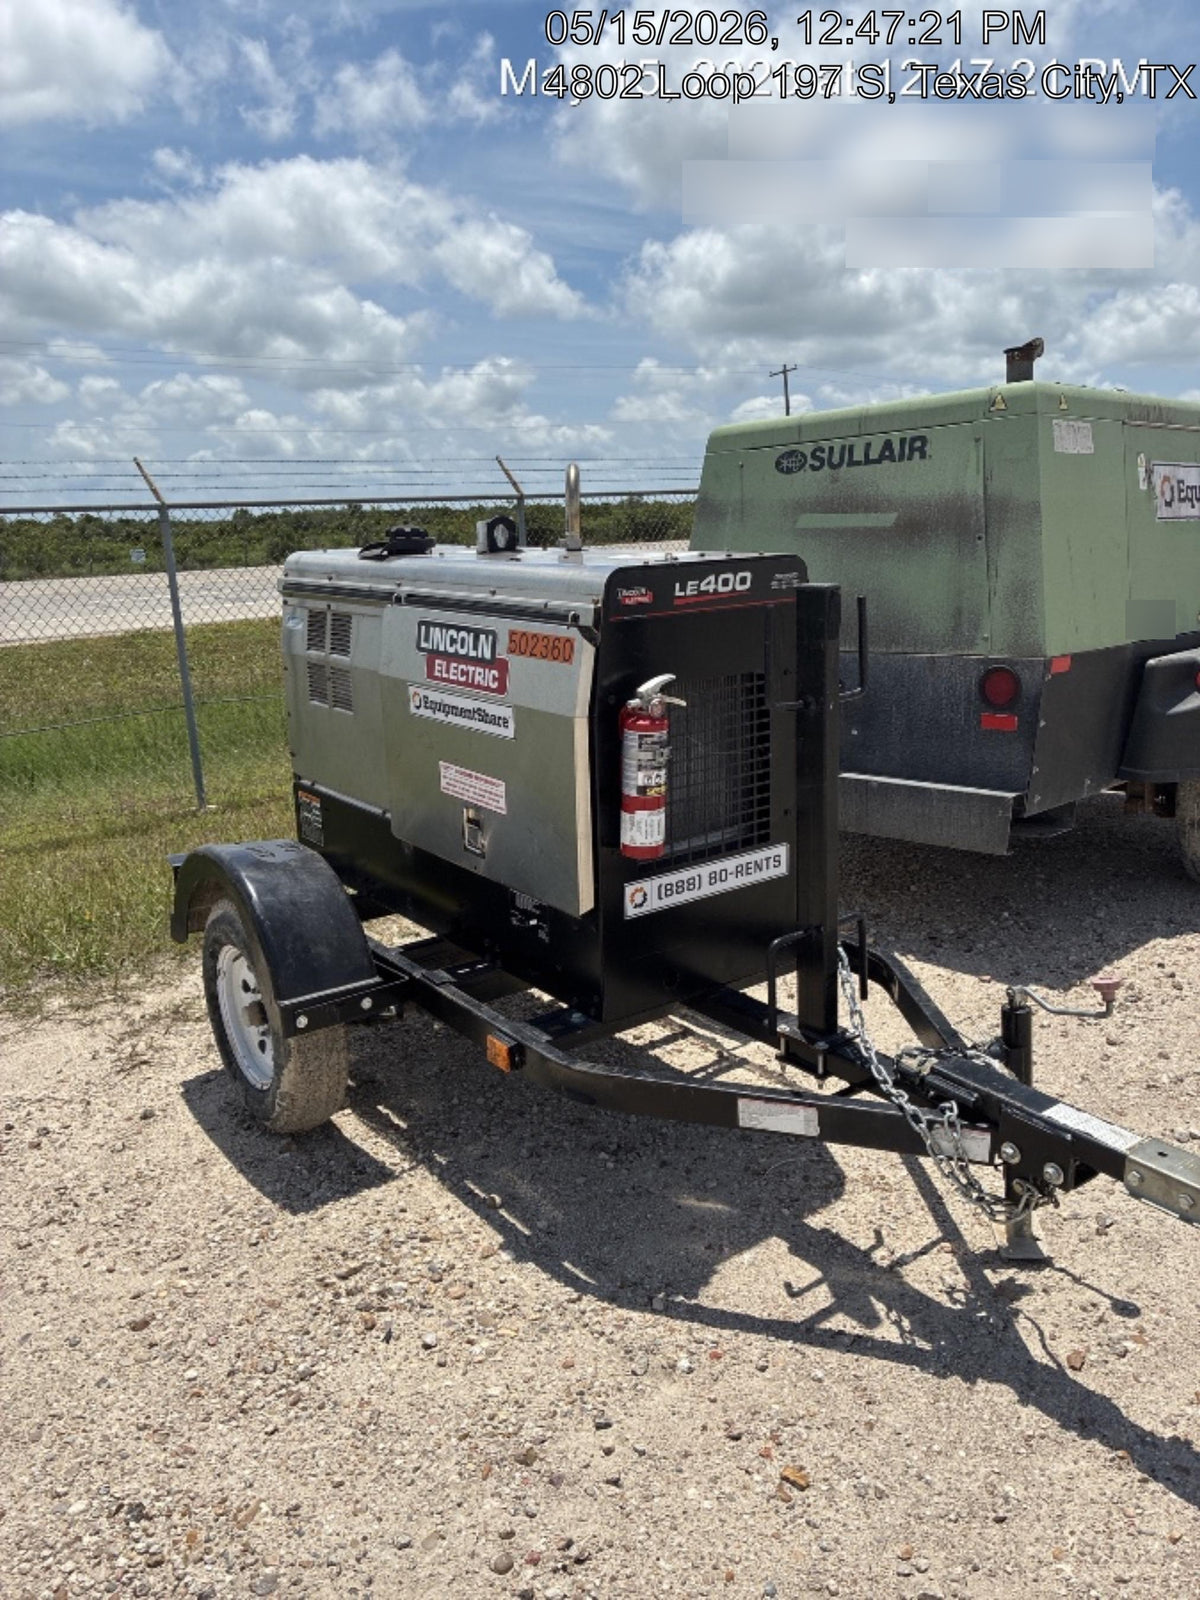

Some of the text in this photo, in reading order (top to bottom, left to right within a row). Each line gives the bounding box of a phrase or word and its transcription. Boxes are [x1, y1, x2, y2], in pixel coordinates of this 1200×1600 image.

[809, 435, 929, 472] SULLAIR
[674, 572, 752, 597] LE400
[420, 625, 493, 660] LINCOLN
[508, 631, 574, 663] 502360
[433, 659, 499, 689] ELECTRIC
[422, 695, 509, 729] EquipmentShare
[657, 874, 702, 900] (888)
